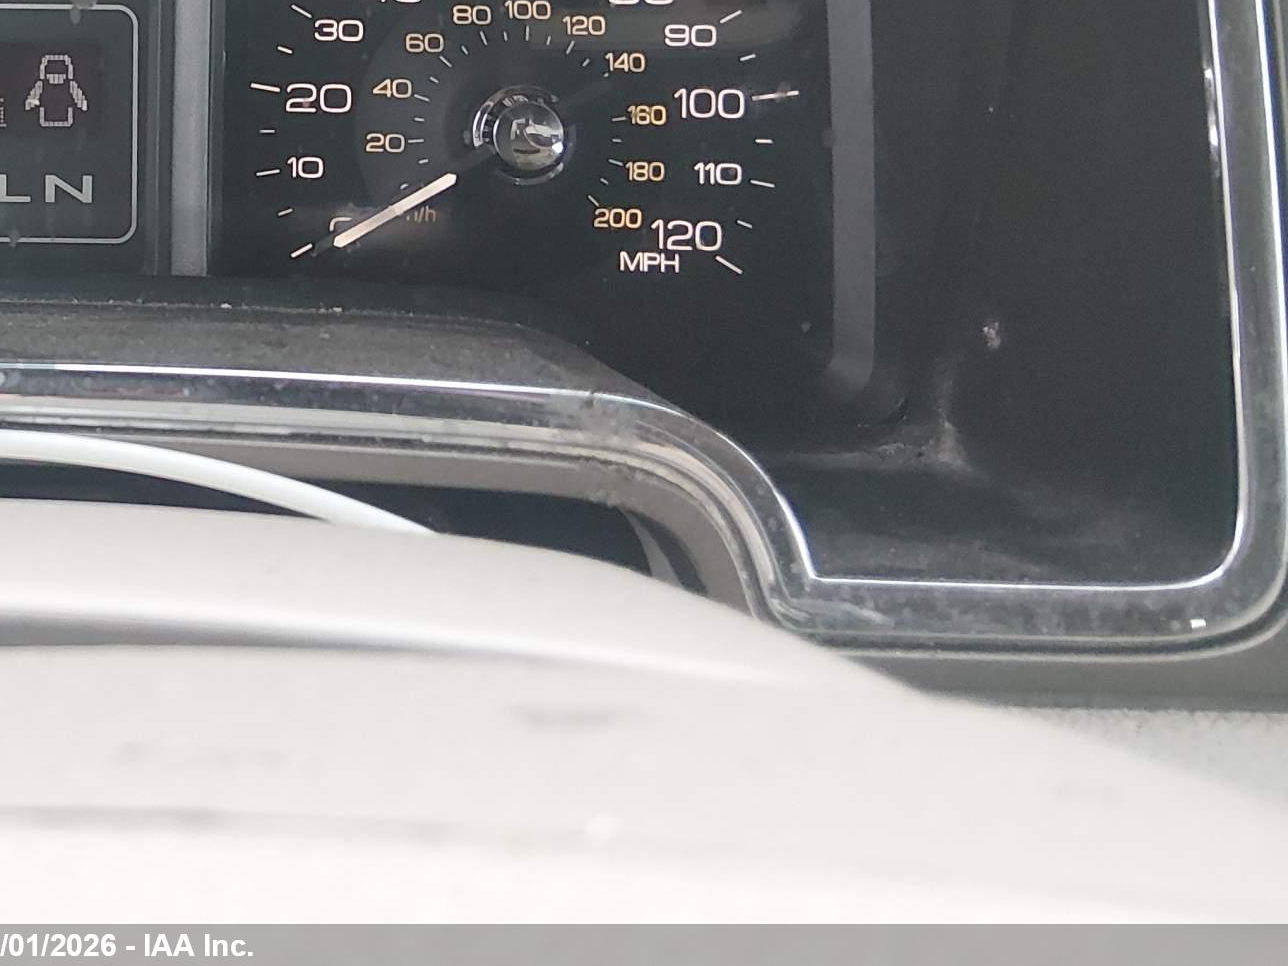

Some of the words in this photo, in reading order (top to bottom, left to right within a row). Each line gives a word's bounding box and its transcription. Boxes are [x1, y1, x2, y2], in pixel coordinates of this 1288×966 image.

[453, 5, 491, 24] 80
[505, 0, 551, 19] 100
[315, 20, 363, 41] 30
[563, 16, 605, 35] 120
[406, 34, 443, 52] 60
[665, 25, 716, 46] 90
[606, 53, 645, 72] 140
[286, 84, 351, 112] 20
[373, 79, 411, 98] 40
[674, 89, 744, 118] 100
[628, 106, 666, 125] 160
[366, 133, 404, 152] 20
[288, 157, 323, 178] 10
[626, 162, 664, 181] 180
[694, 163, 742, 184] 110
[594, 209, 641, 228] 200
[651, 220, 722, 251] 120
[620, 251, 679, 272] MPH
